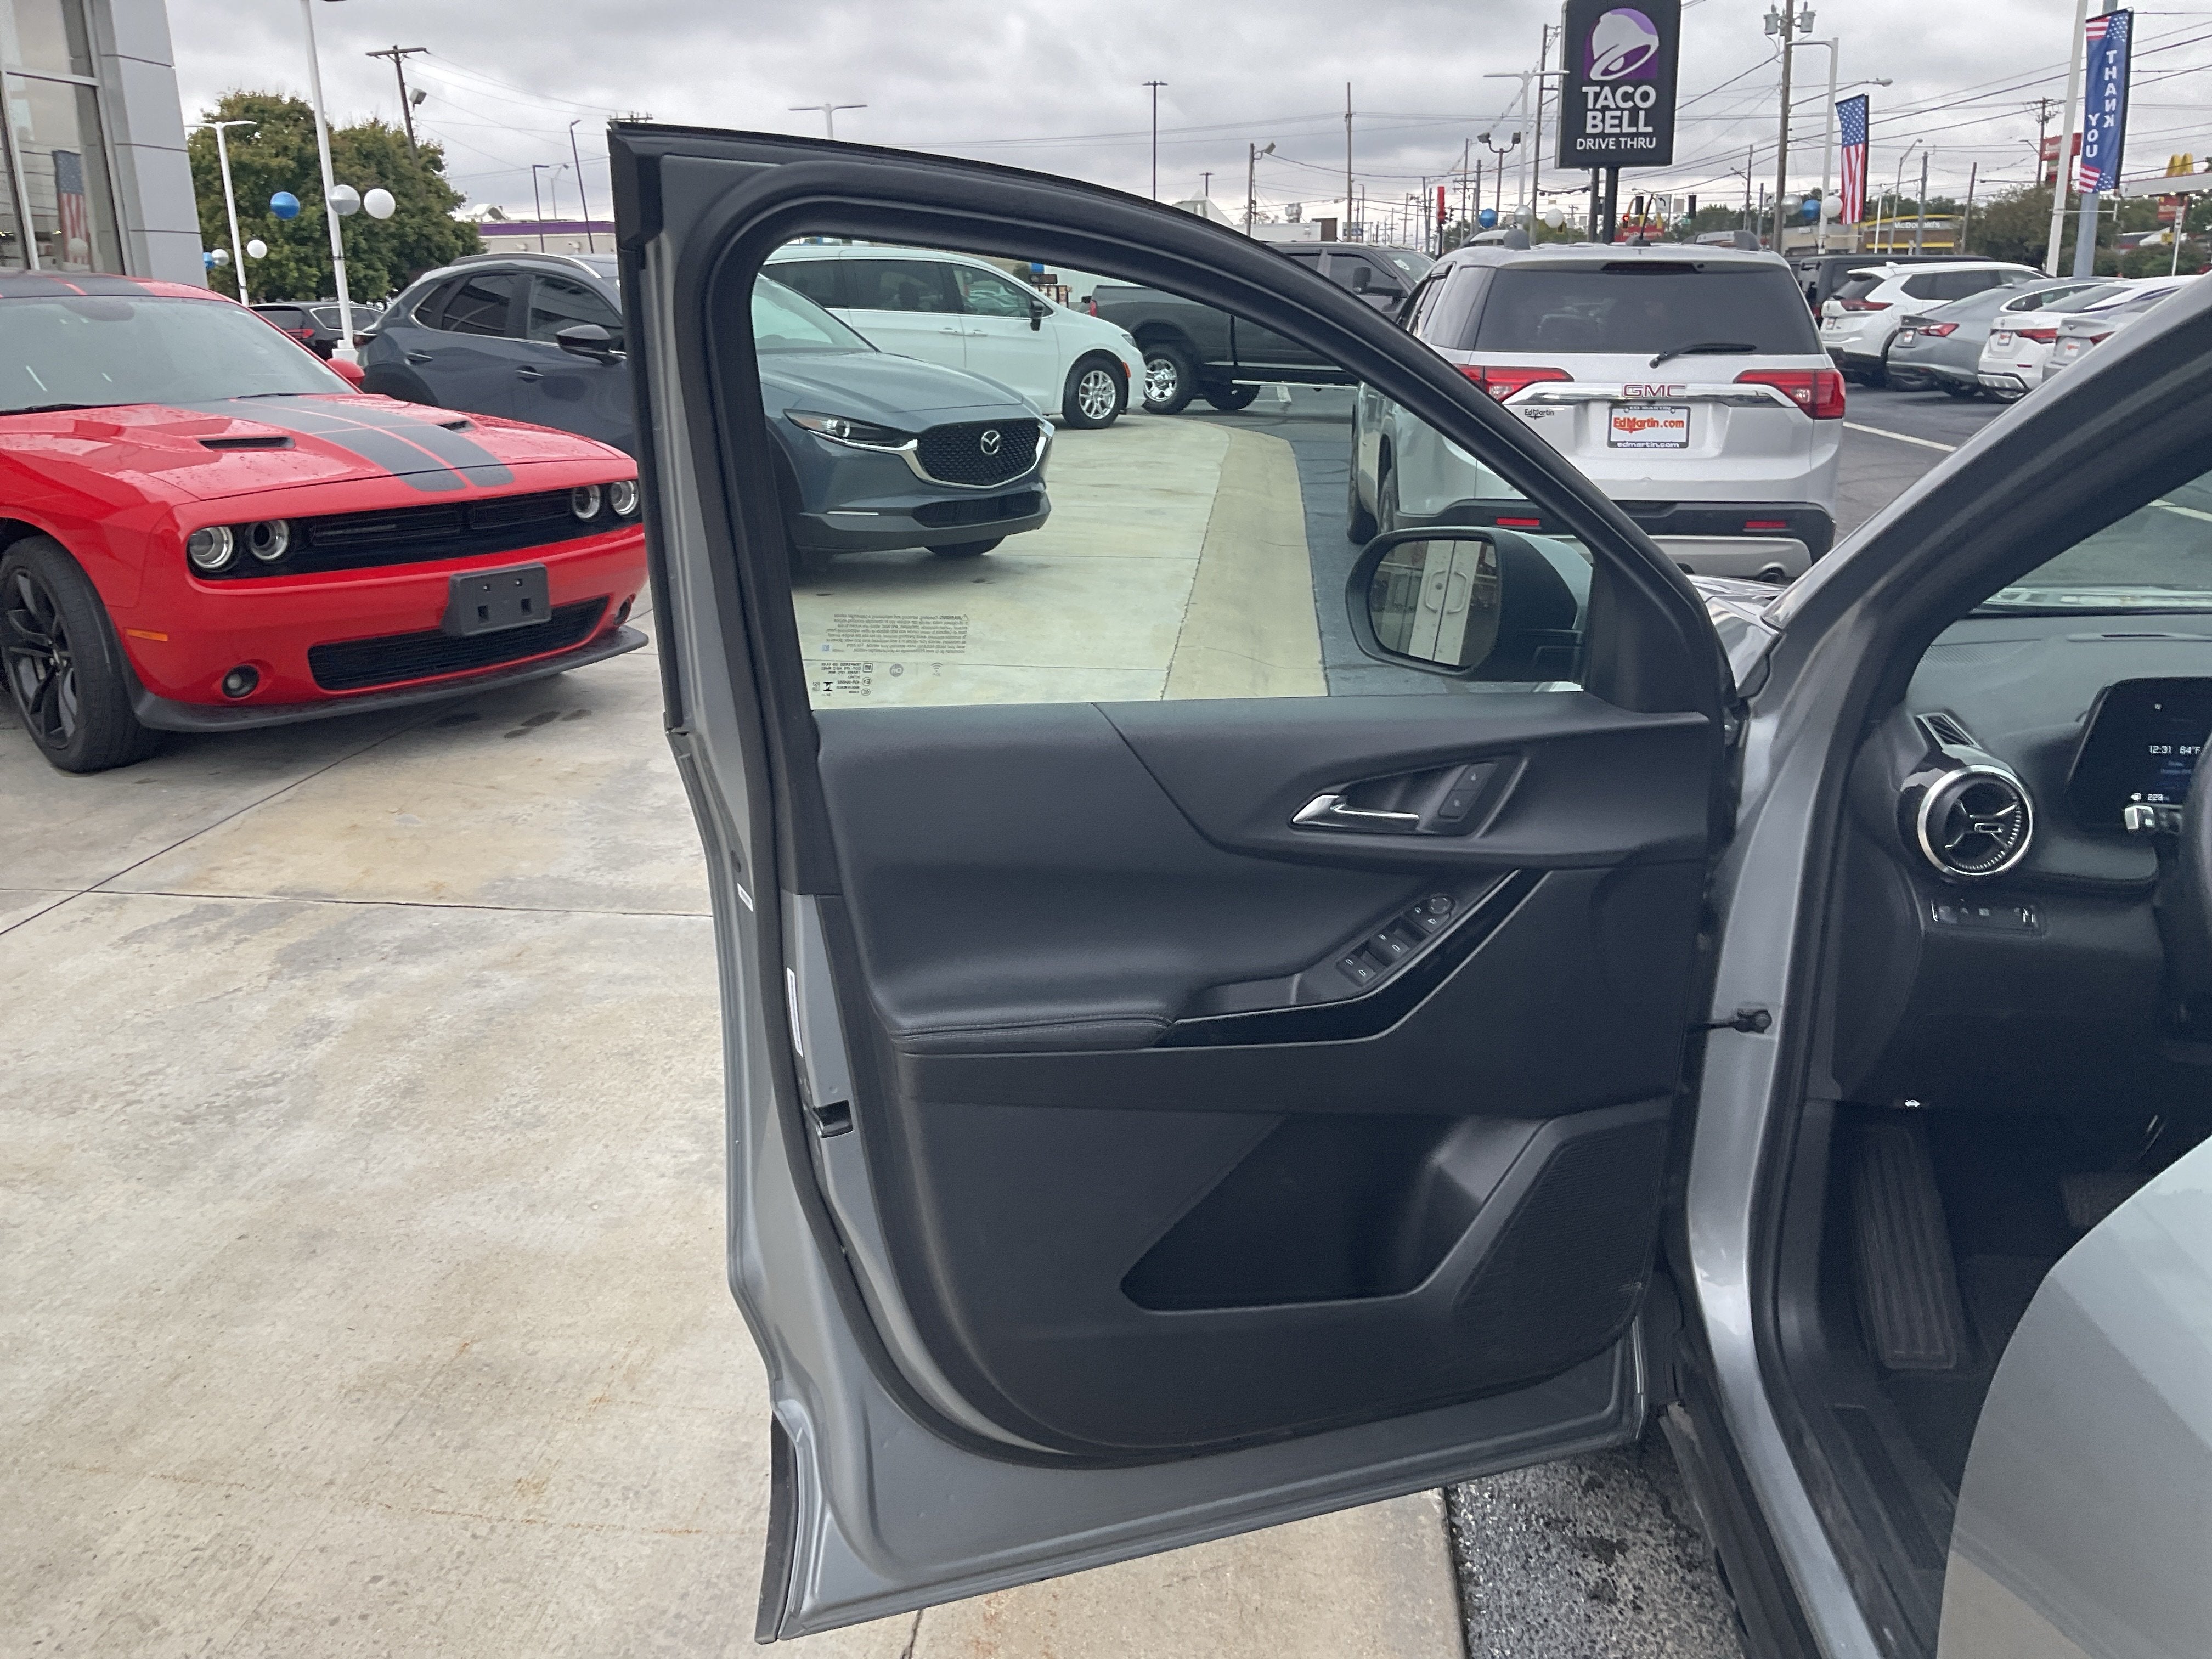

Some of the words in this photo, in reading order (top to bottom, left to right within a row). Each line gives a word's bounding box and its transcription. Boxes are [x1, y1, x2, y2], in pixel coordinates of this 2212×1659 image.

[1582, 85, 1656, 109] TACO
[1585, 110, 1653, 134] BELL
[1576, 138, 1616, 150] DRIVE
[1619, 137, 1656, 149] THRU
[1622, 383, 1686, 398] GMC
